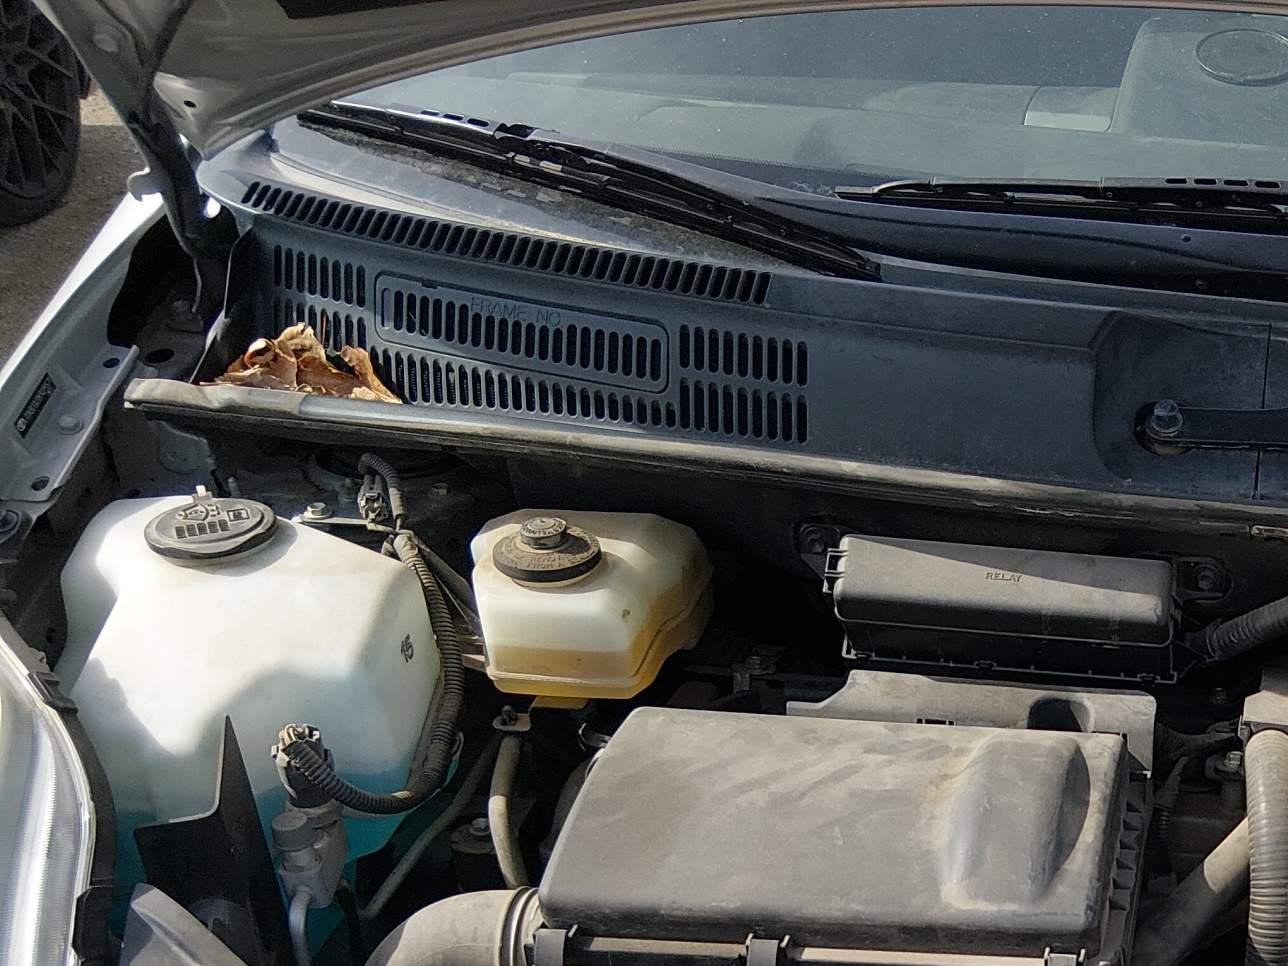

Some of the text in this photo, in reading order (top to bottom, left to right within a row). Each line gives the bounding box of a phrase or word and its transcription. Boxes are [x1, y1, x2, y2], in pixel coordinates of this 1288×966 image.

[471, 297, 562, 327] FRAME NO
[985, 571, 1023, 583] RELAY
